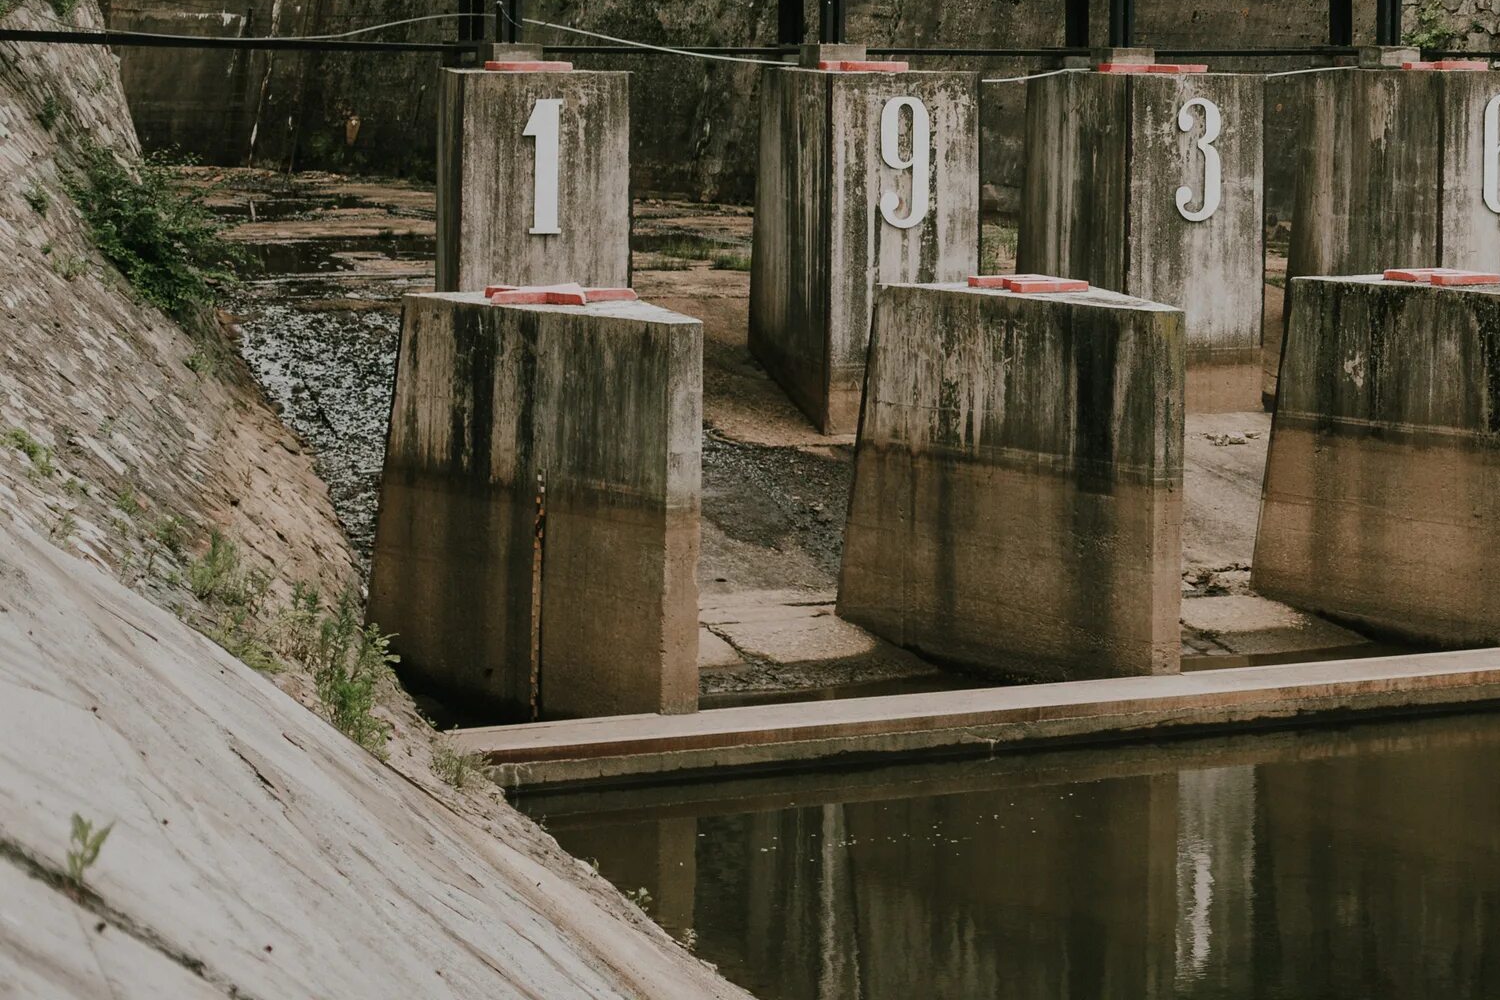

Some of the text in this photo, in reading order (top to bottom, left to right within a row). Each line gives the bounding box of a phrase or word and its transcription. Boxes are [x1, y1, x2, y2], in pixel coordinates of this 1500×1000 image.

[522, 98, 563, 234] 1
[879, 96, 930, 229] 9
[1175, 97, 1221, 222] 3
